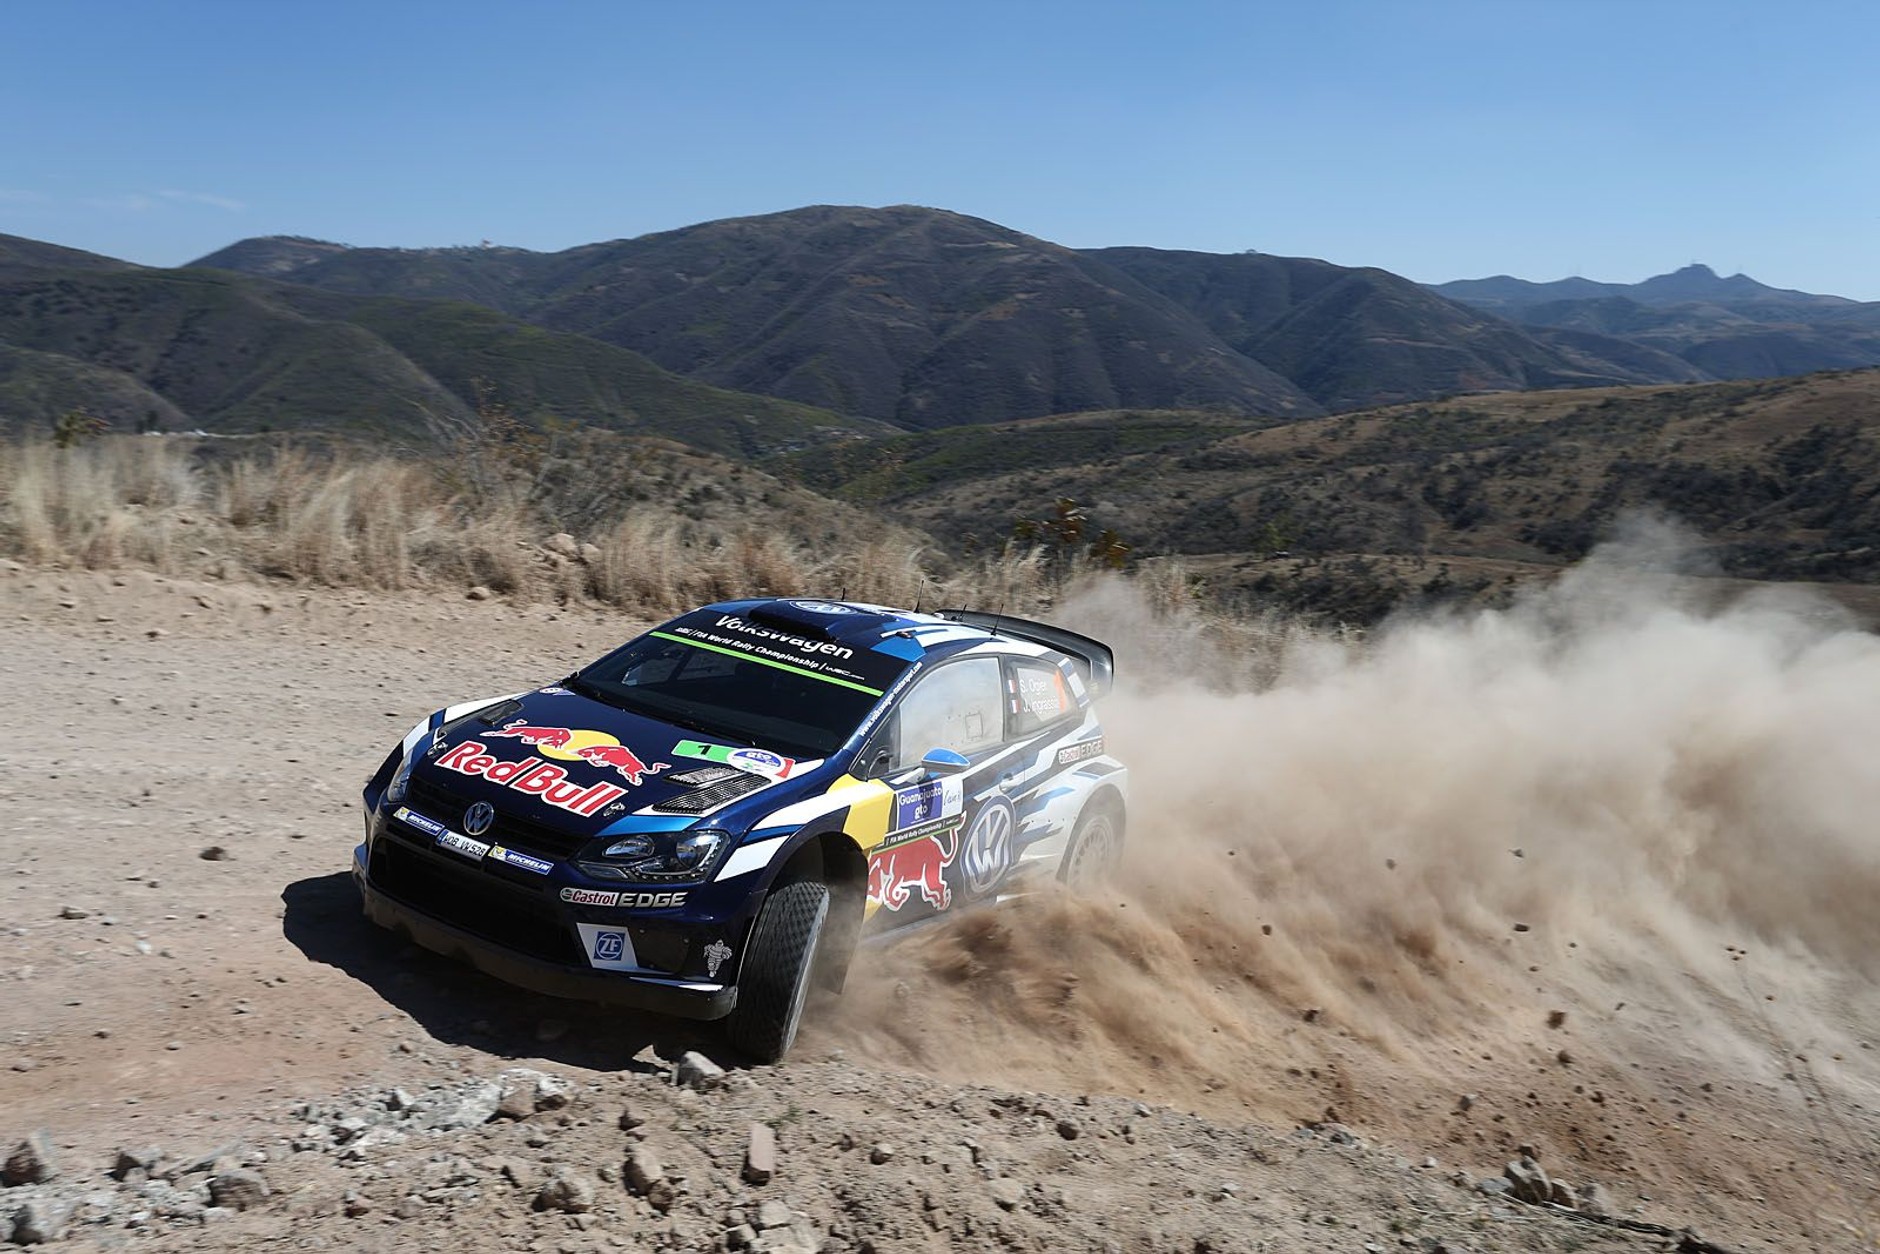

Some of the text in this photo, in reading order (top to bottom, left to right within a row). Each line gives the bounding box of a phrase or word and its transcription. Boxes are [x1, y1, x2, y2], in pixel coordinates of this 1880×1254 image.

[715, 614, 854, 660] Volkswagen
[707, 634, 733, 645] World
[731, 639, 755, 651] Rally
[755, 646, 819, 669] Championship
[698, 745, 712, 755] 1
[1081, 740, 1103, 757] EDGE
[899, 785, 943, 807] Guanajuato
[914, 803, 928, 820] gto
[407, 814, 441, 832] MICHELIN
[507, 853, 550, 872] MICHELIN
[572, 890, 688, 907] Castrol EDGE
